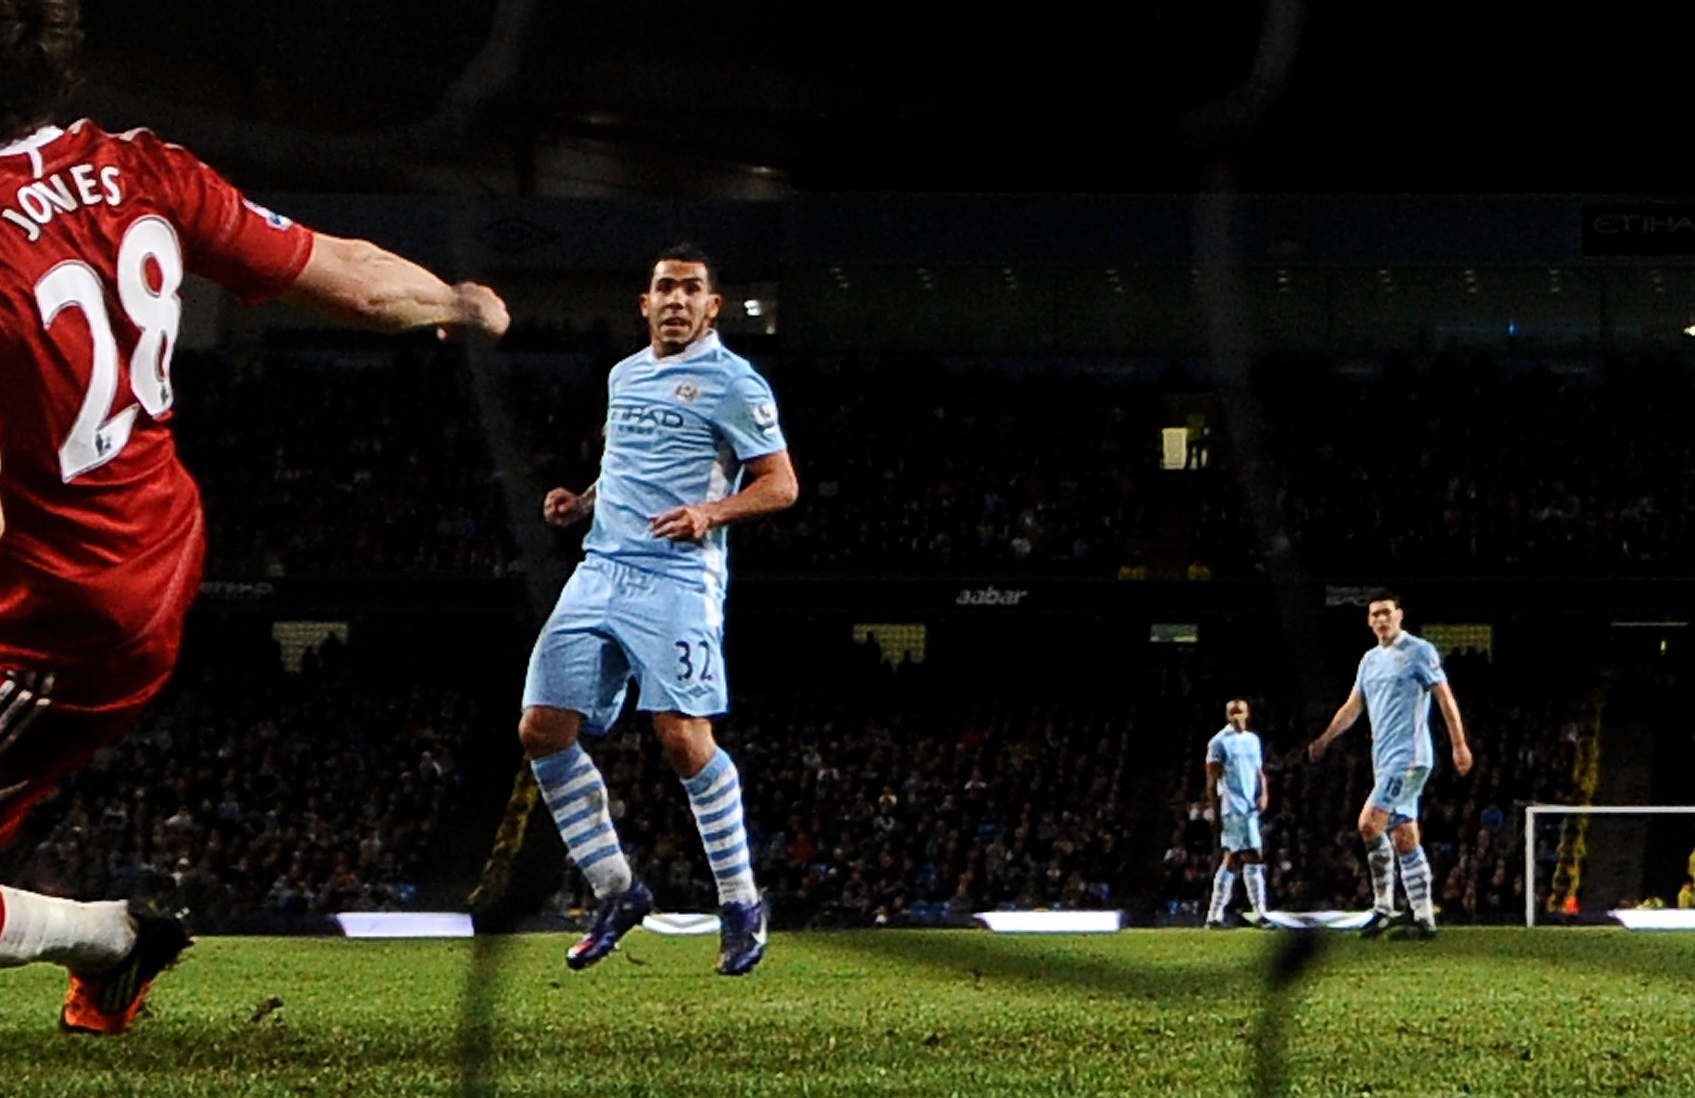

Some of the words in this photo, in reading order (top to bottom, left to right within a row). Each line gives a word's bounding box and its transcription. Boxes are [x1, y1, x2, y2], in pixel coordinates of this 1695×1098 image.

[2, 163, 121, 242] JONES
[34, 214, 183, 484] 28
[674, 640, 714, 682] 32
